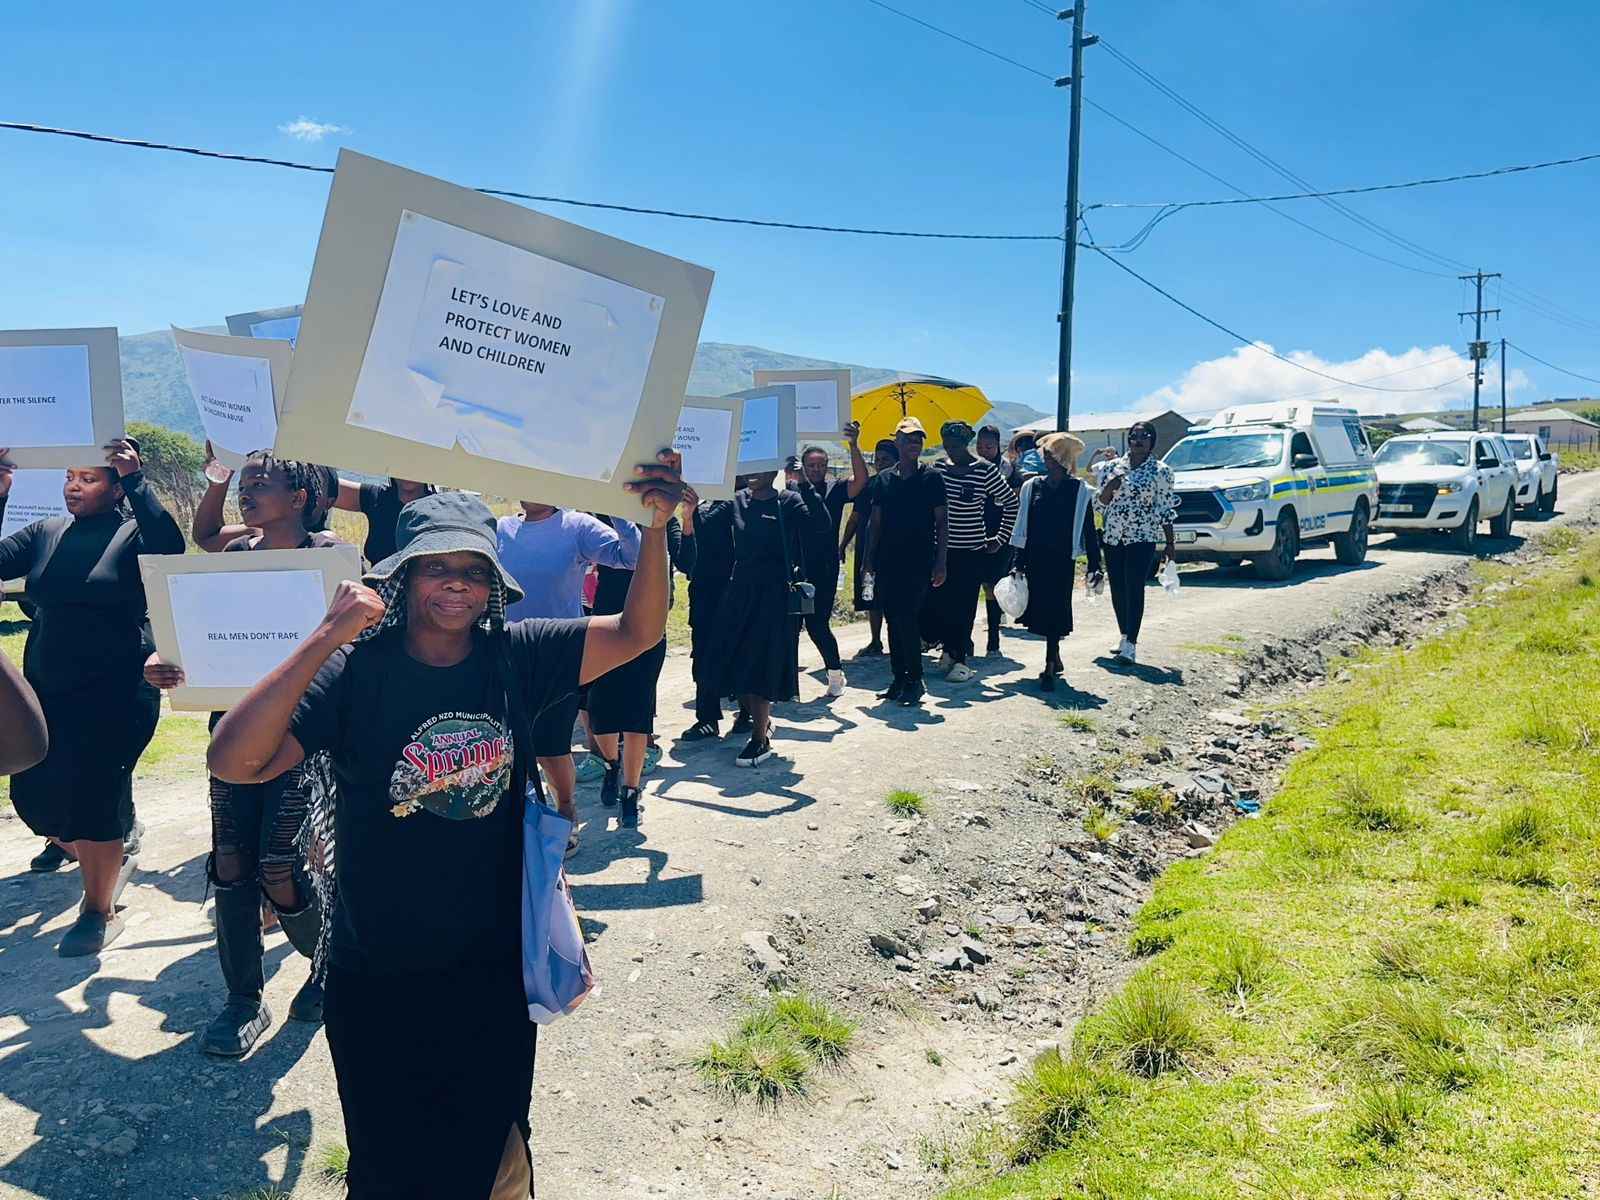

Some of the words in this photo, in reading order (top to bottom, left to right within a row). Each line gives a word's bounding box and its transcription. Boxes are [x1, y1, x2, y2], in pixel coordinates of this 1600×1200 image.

[451, 287, 489, 309] LET’S
[492, 299, 530, 321] LOVE
[531, 312, 562, 330] AND
[445, 312, 512, 340] PROTECT
[514, 331, 571, 357] WOMEN
[438, 336, 473, 355] AND
[476, 346, 546, 375] CHILDREN
[13, 396, 26, 404] THE
[28, 396, 57, 404] SILENCE
[228, 402, 251, 413] WOMEN
[1300, 514, 1326, 530] POLICE
[208, 632, 228, 640] REAL
[229, 632, 248, 640] MEN
[278, 632, 299, 640] RAPE
[410, 716, 438, 741] ALFRED
[438, 711, 454, 720] NZO
[431, 728, 482, 746] ANNUAL
